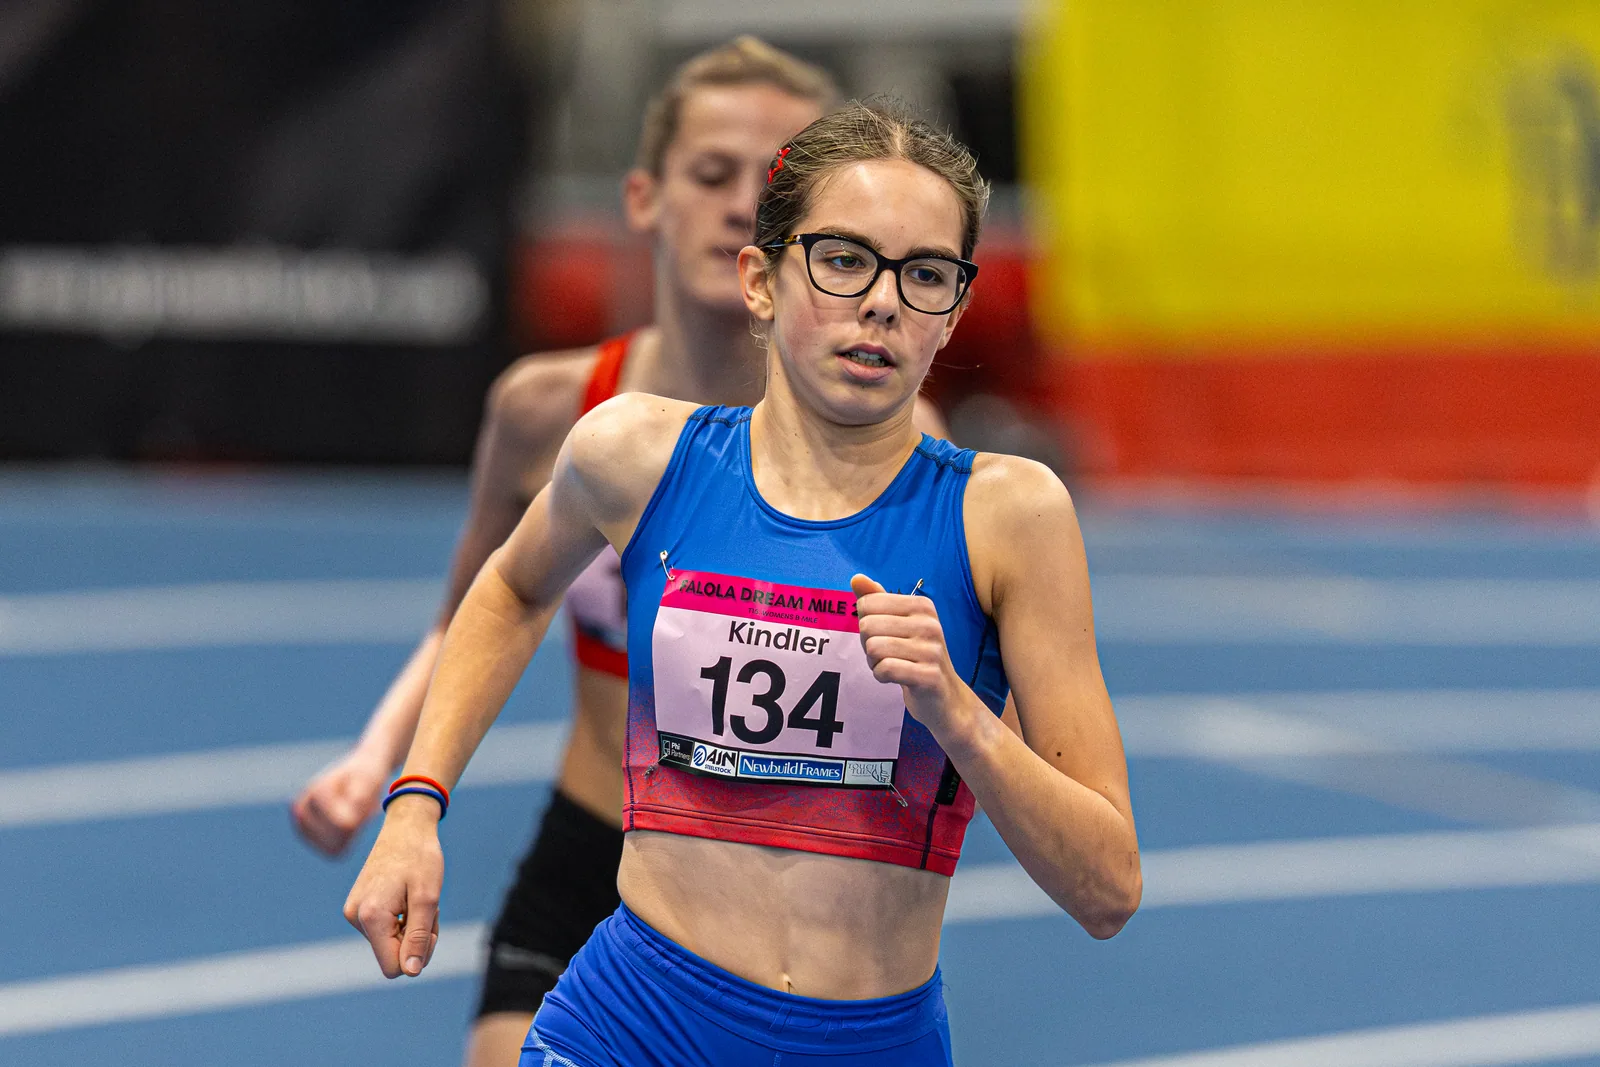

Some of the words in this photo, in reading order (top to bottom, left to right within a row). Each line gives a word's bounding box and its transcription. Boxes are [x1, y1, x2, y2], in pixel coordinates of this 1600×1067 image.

[679, 580, 736, 599] FALOLA
[740, 587, 803, 610] DREAM
[808, 598, 847, 616] MILE
[762, 610, 794, 620] WOMENS
[728, 620, 830, 655] Kindler
[700, 656, 844, 748] 134
[671, 742, 681, 751] Phi
[707, 749, 736, 768] AJN
[704, 764, 731, 774] STEELSTOCK
